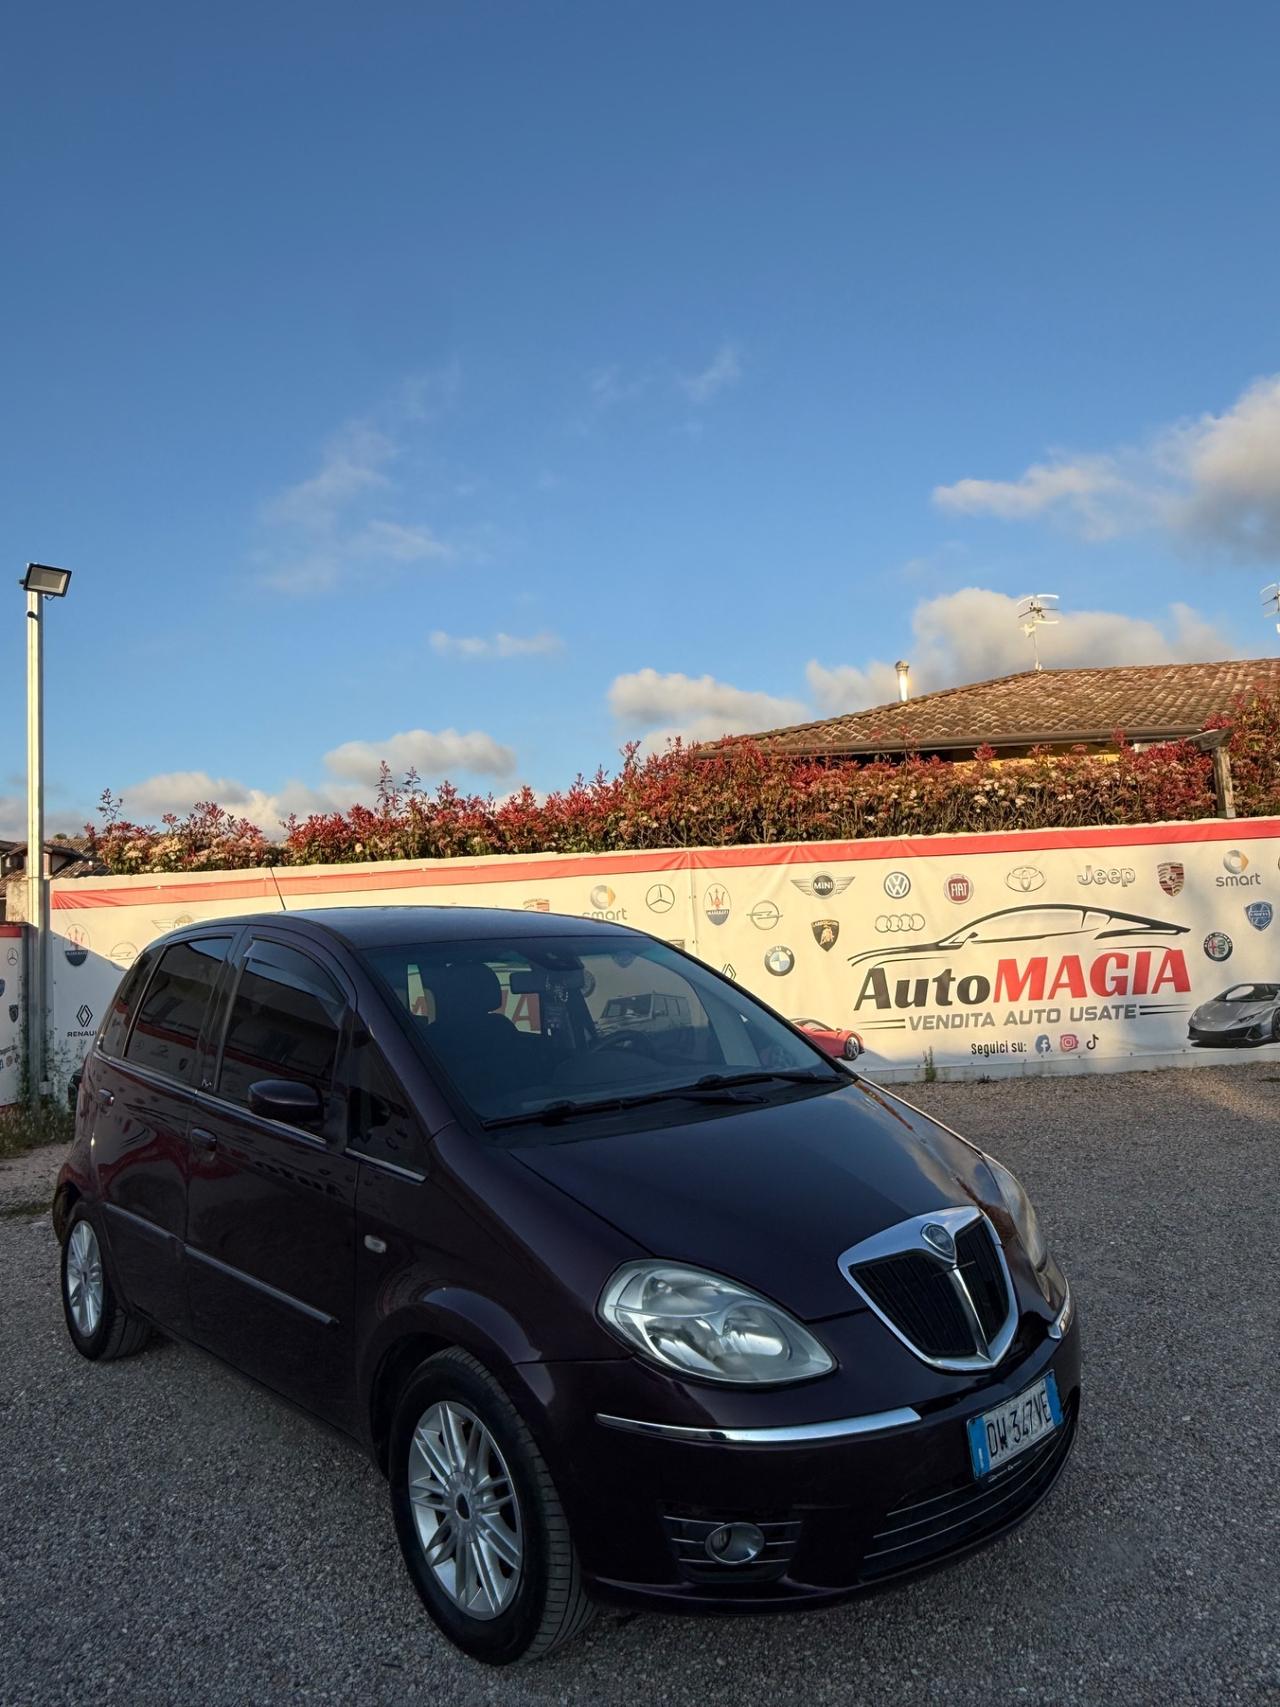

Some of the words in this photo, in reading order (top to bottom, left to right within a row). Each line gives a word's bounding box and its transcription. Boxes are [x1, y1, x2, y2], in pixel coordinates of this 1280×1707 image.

[1076, 865, 1136, 887] Jeep
[1215, 873, 1262, 887] smart
[814, 882, 834, 890] MINI
[950, 882, 968, 897] FIAT
[909, 1012, 996, 1031] VENDITA
[1003, 1008, 1061, 1026] AUTO
[1069, 1004, 1137, 1022] USATE
[66, 1030, 98, 1038] RENAU
[971, 1041, 1009, 1058] Seguici
[986, 1417, 1009, 1458] DW
